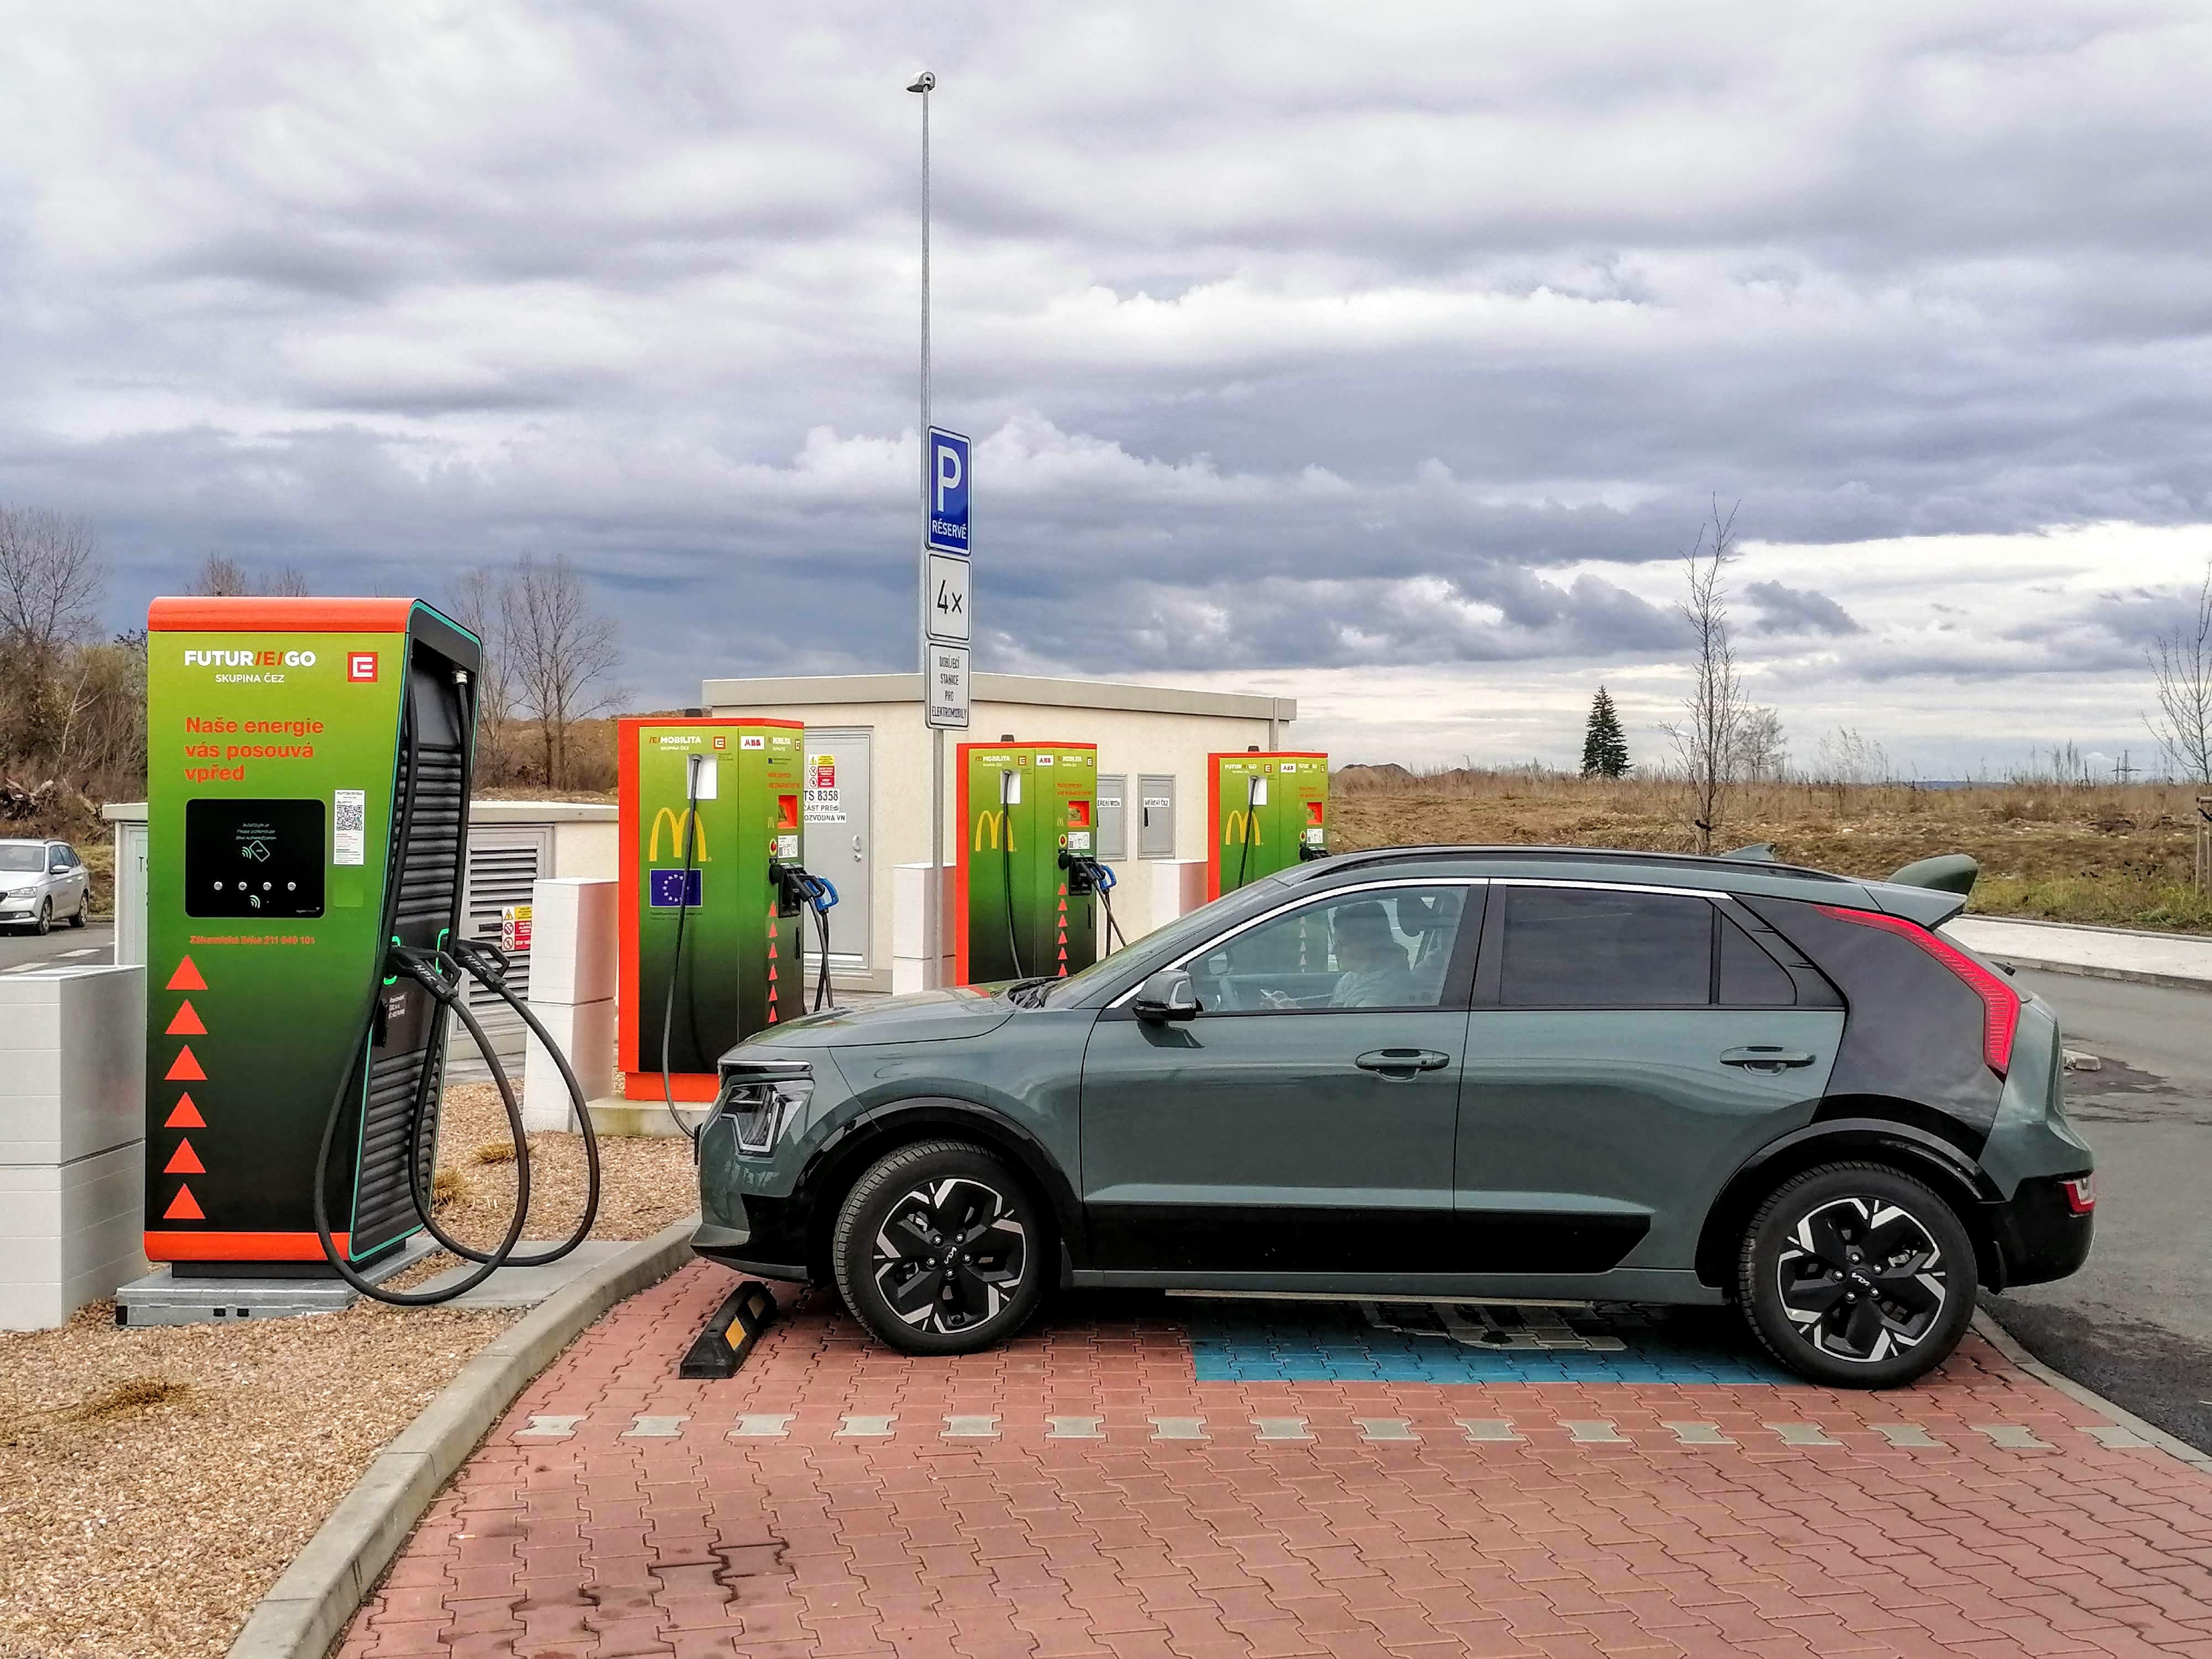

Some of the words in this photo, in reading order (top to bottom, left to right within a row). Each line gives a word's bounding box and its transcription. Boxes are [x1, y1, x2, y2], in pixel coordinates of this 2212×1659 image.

[937, 444, 962, 513] P
[932, 518, 967, 540] RÉSERVÉ
[215, 674, 261, 683] SKUPINA
[264, 672, 284, 683] ČEZ
[940, 673, 959, 686] STANICE
[186, 717, 238, 734] Naše
[244, 718, 325, 737] energie
[185, 741, 221, 758] vás
[227, 742, 314, 760] posouvá
[185, 764, 245, 783] vpřed
[804, 790, 815, 801] TS
[817, 790, 838, 801] 8358
